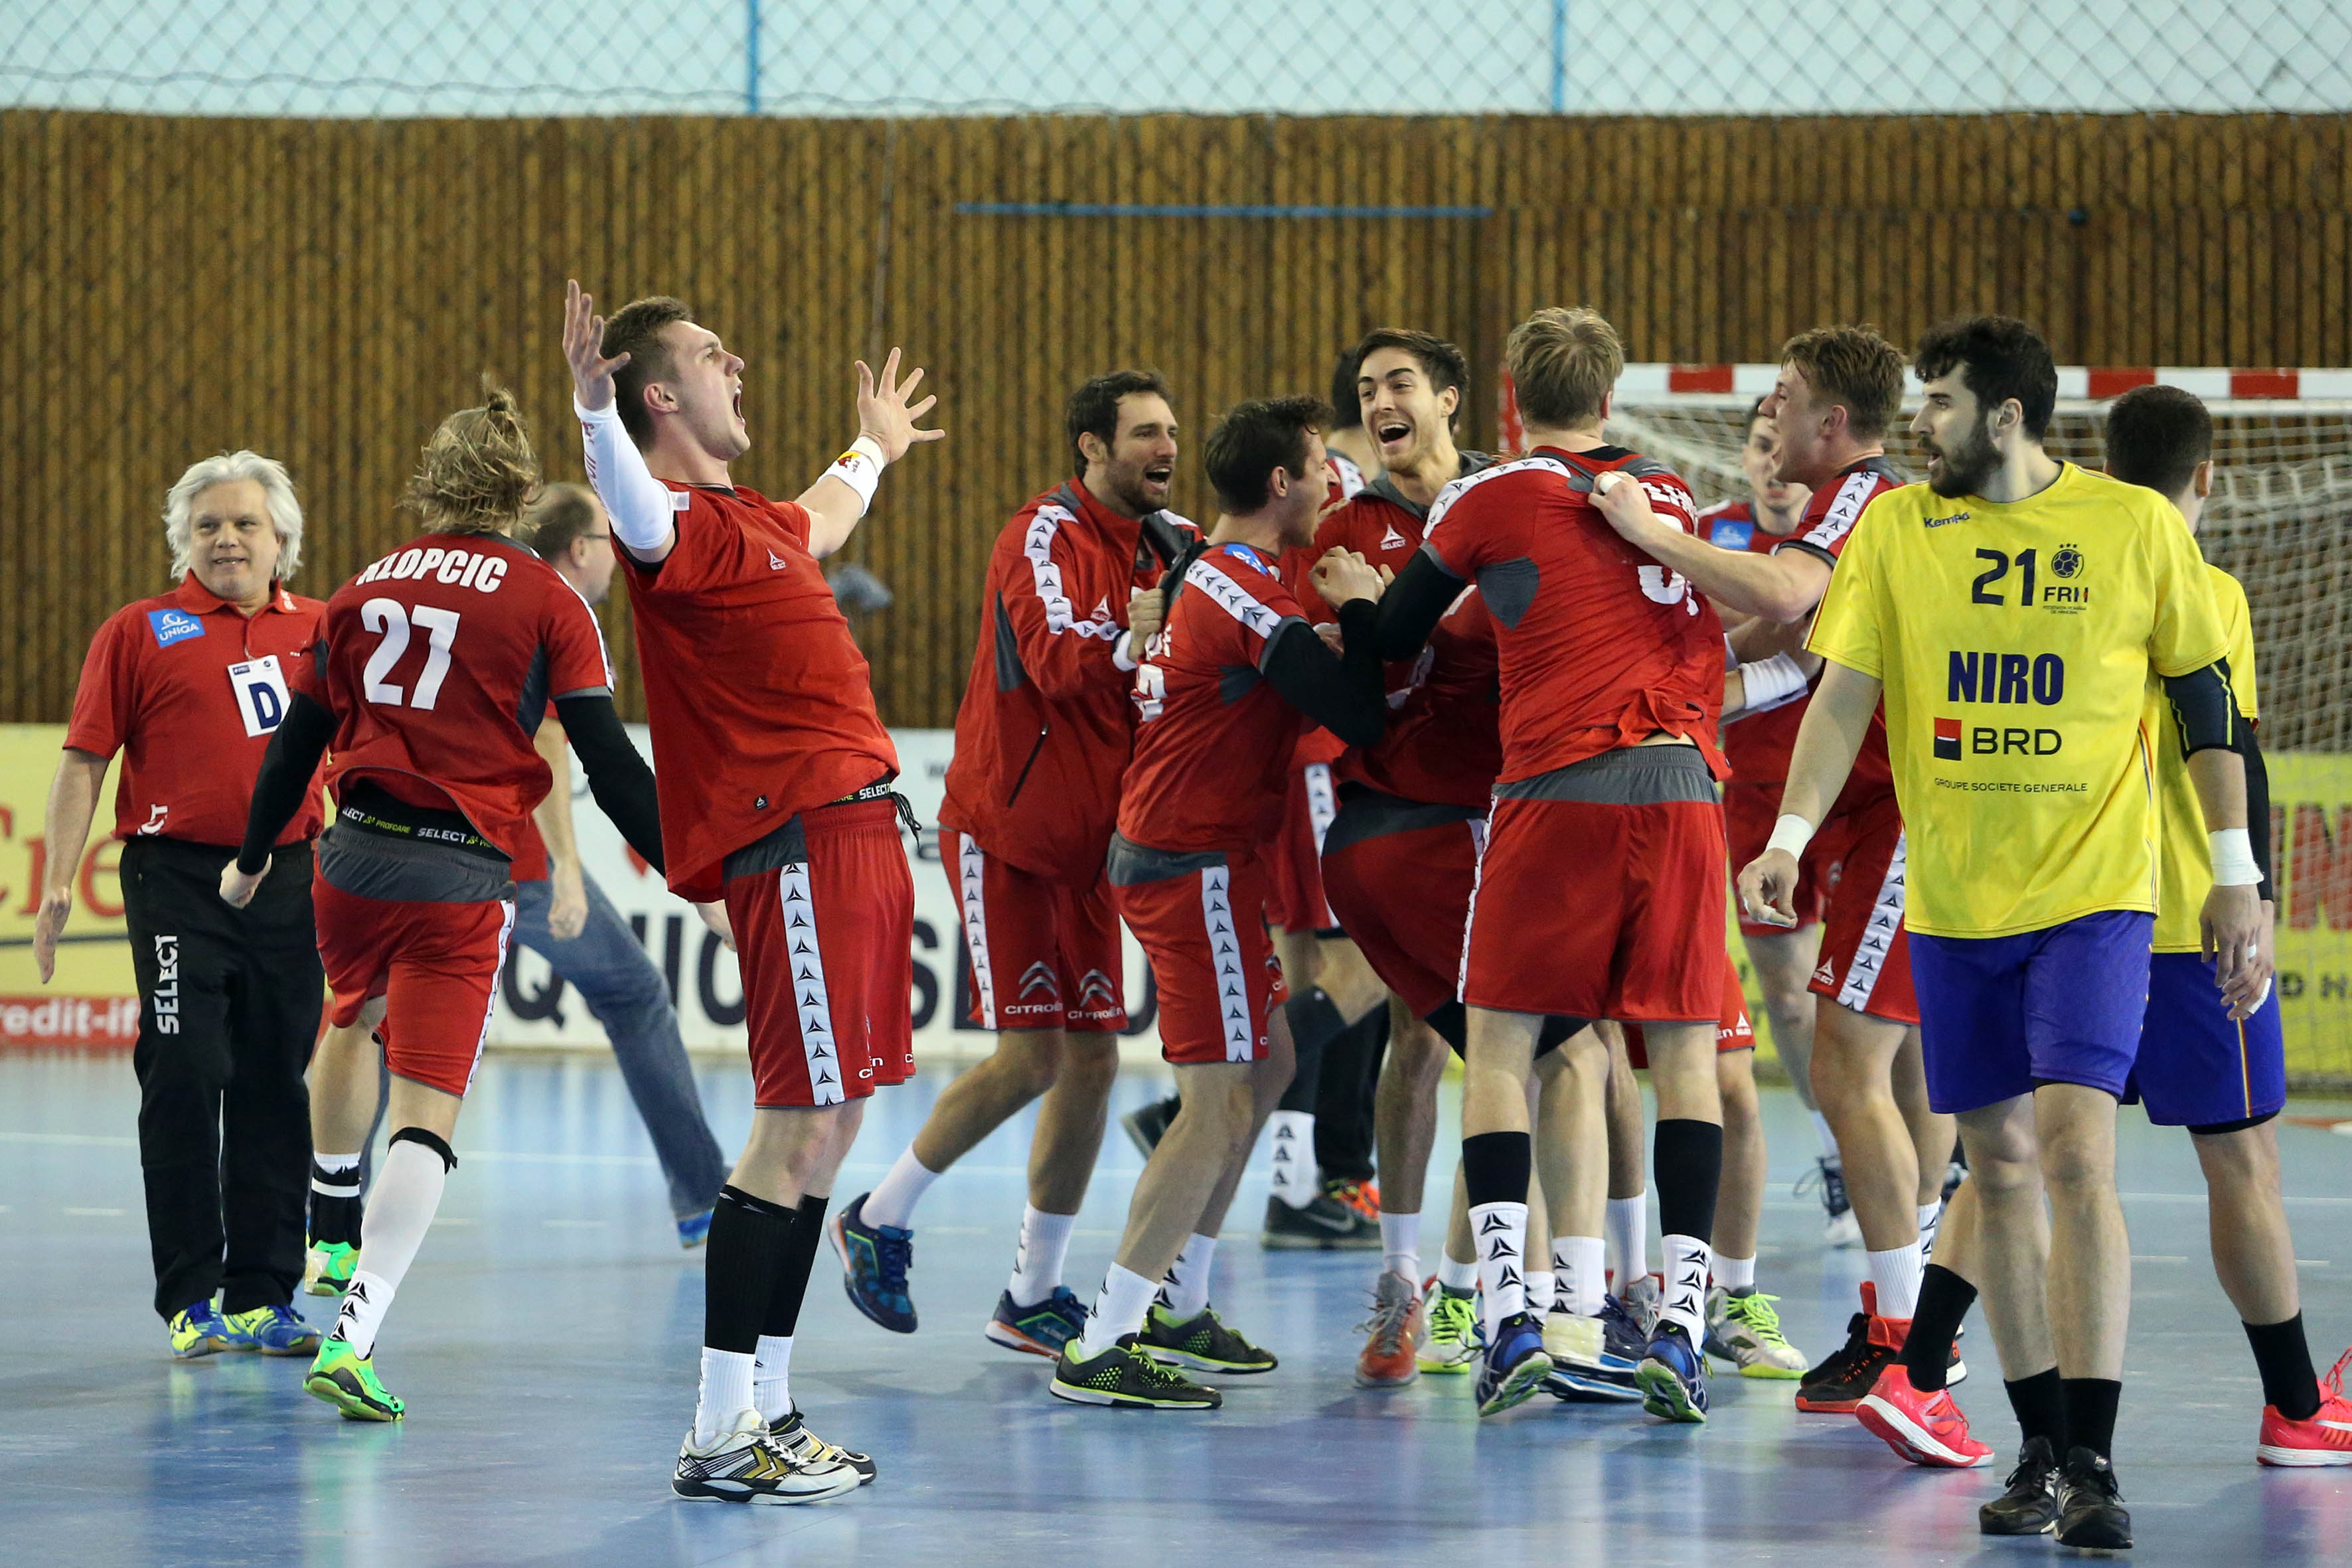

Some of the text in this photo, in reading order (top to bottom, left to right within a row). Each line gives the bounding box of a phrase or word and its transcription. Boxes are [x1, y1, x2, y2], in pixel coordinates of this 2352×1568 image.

[1924, 512, 1970, 528] Kempa
[1972, 548, 2037, 606] 21
[159, 623, 199, 641] UNIQA
[360, 597, 461, 710] 27
[1948, 651, 2065, 706] NIRO
[248, 682, 281, 730] D
[1972, 728, 2062, 755] BRD
[859, 783, 888, 800] SELECT
[1934, 777, 2088, 793] GROUPE SOCIETE GENERALE
[418, 827, 467, 843] SELECT
[155, 935, 179, 1034] SELECT
